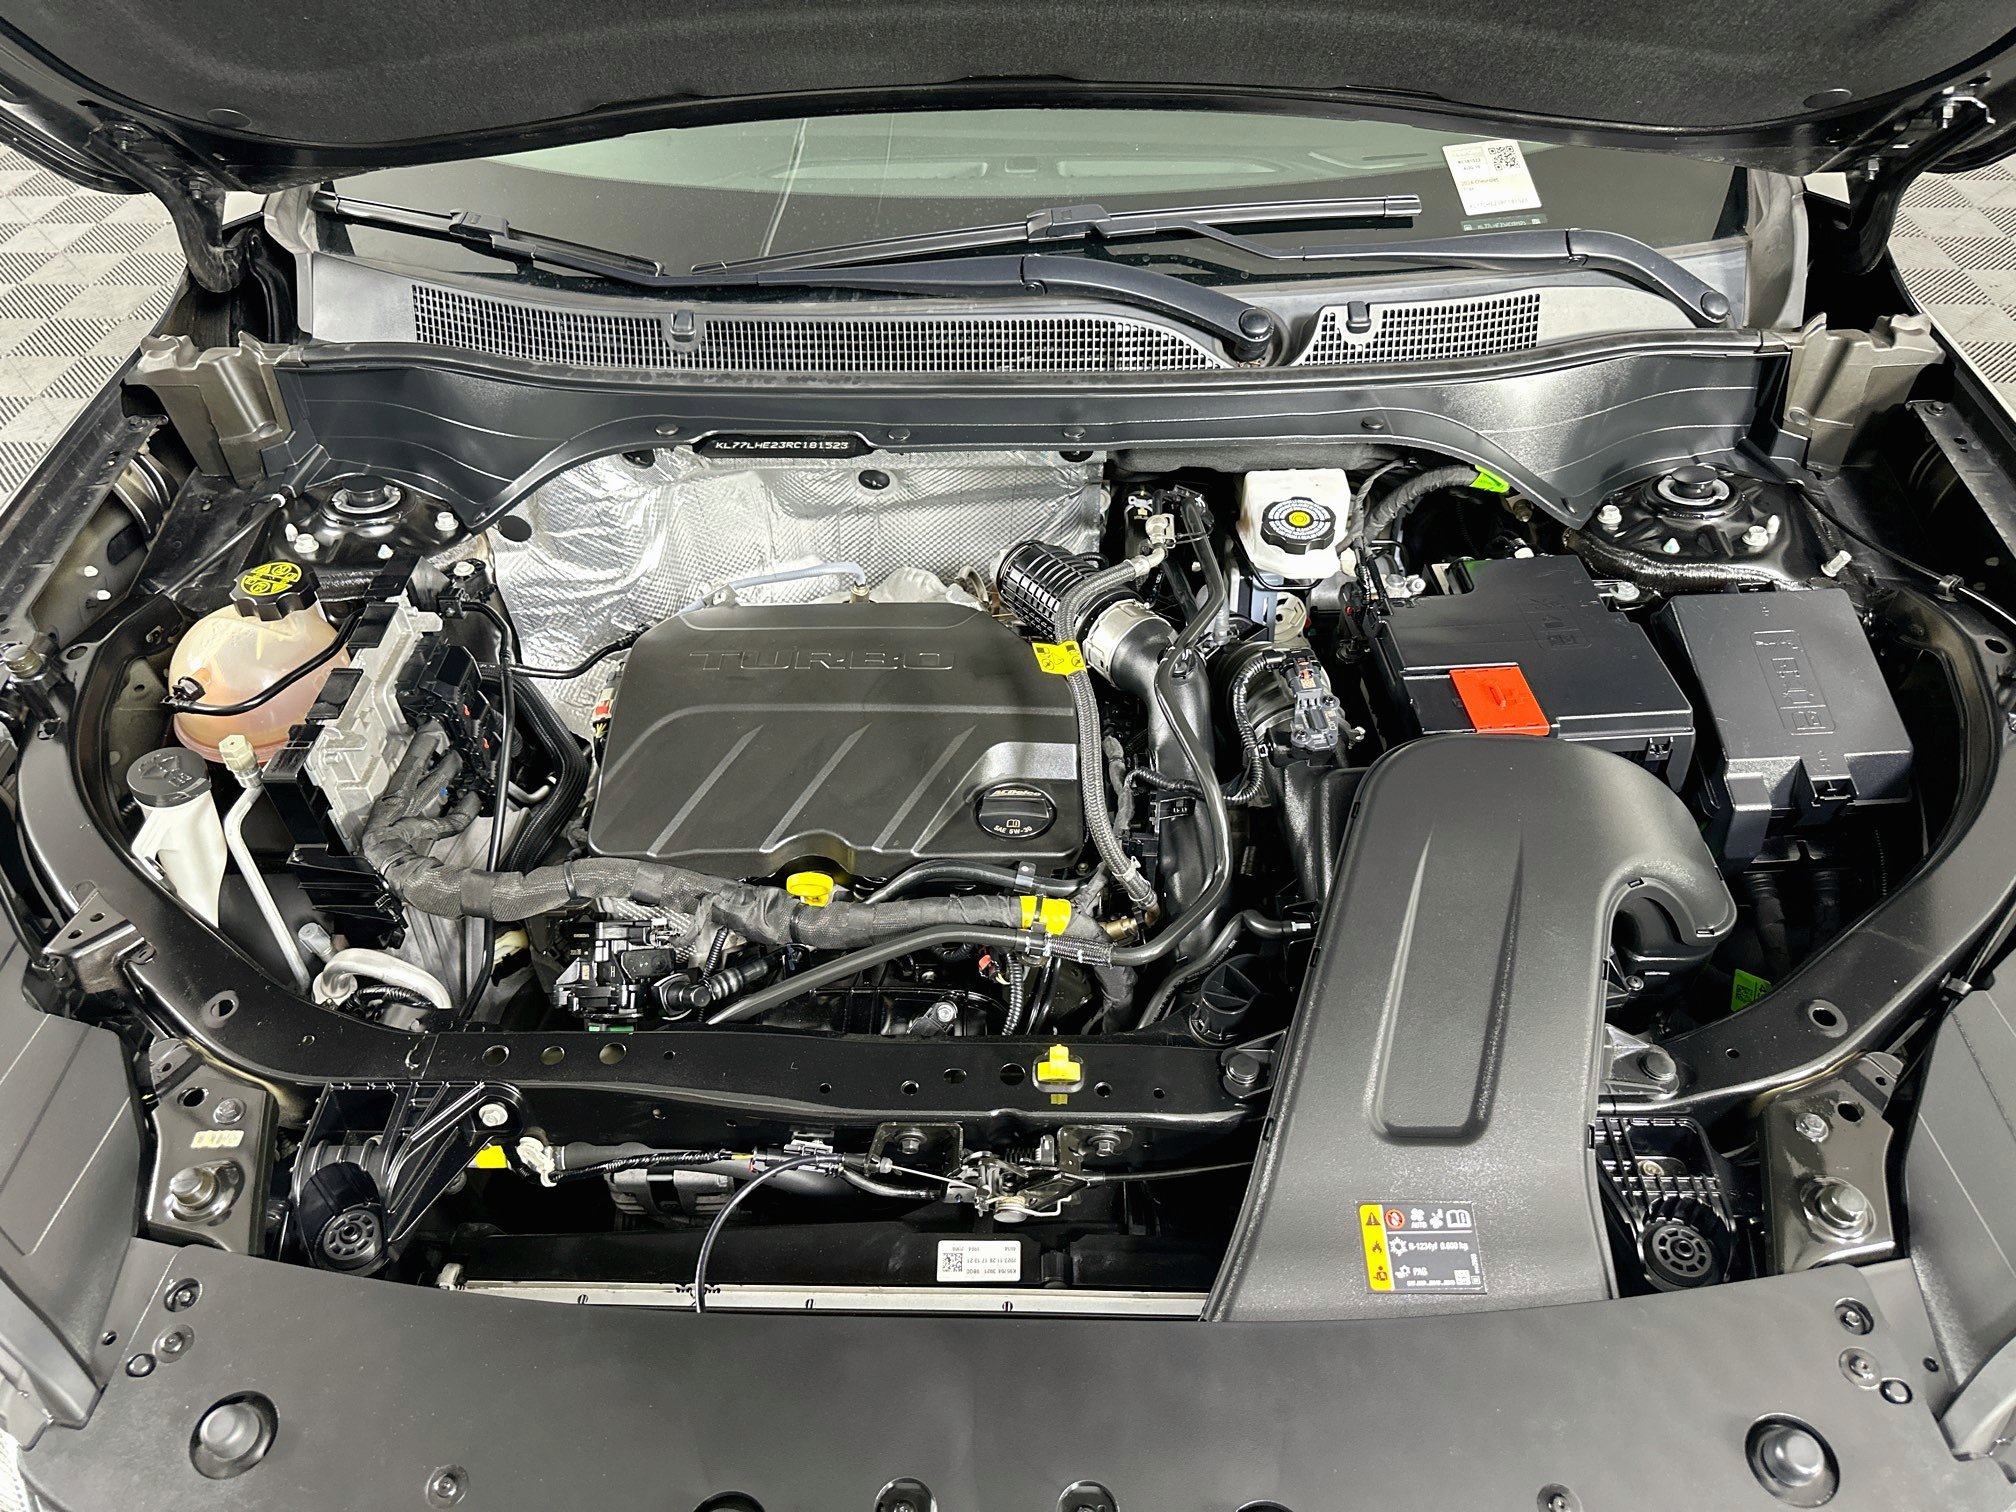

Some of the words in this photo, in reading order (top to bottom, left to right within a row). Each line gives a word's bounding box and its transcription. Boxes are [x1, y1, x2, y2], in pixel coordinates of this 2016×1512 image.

[715, 441, 849, 450] KL77LHE23RC181523
[690, 650, 954, 670] TURBO
[990, 789, 1042, 797] ACDelco
[993, 825, 1006, 834] SAE
[1009, 825, 1033, 835] 5W-30
